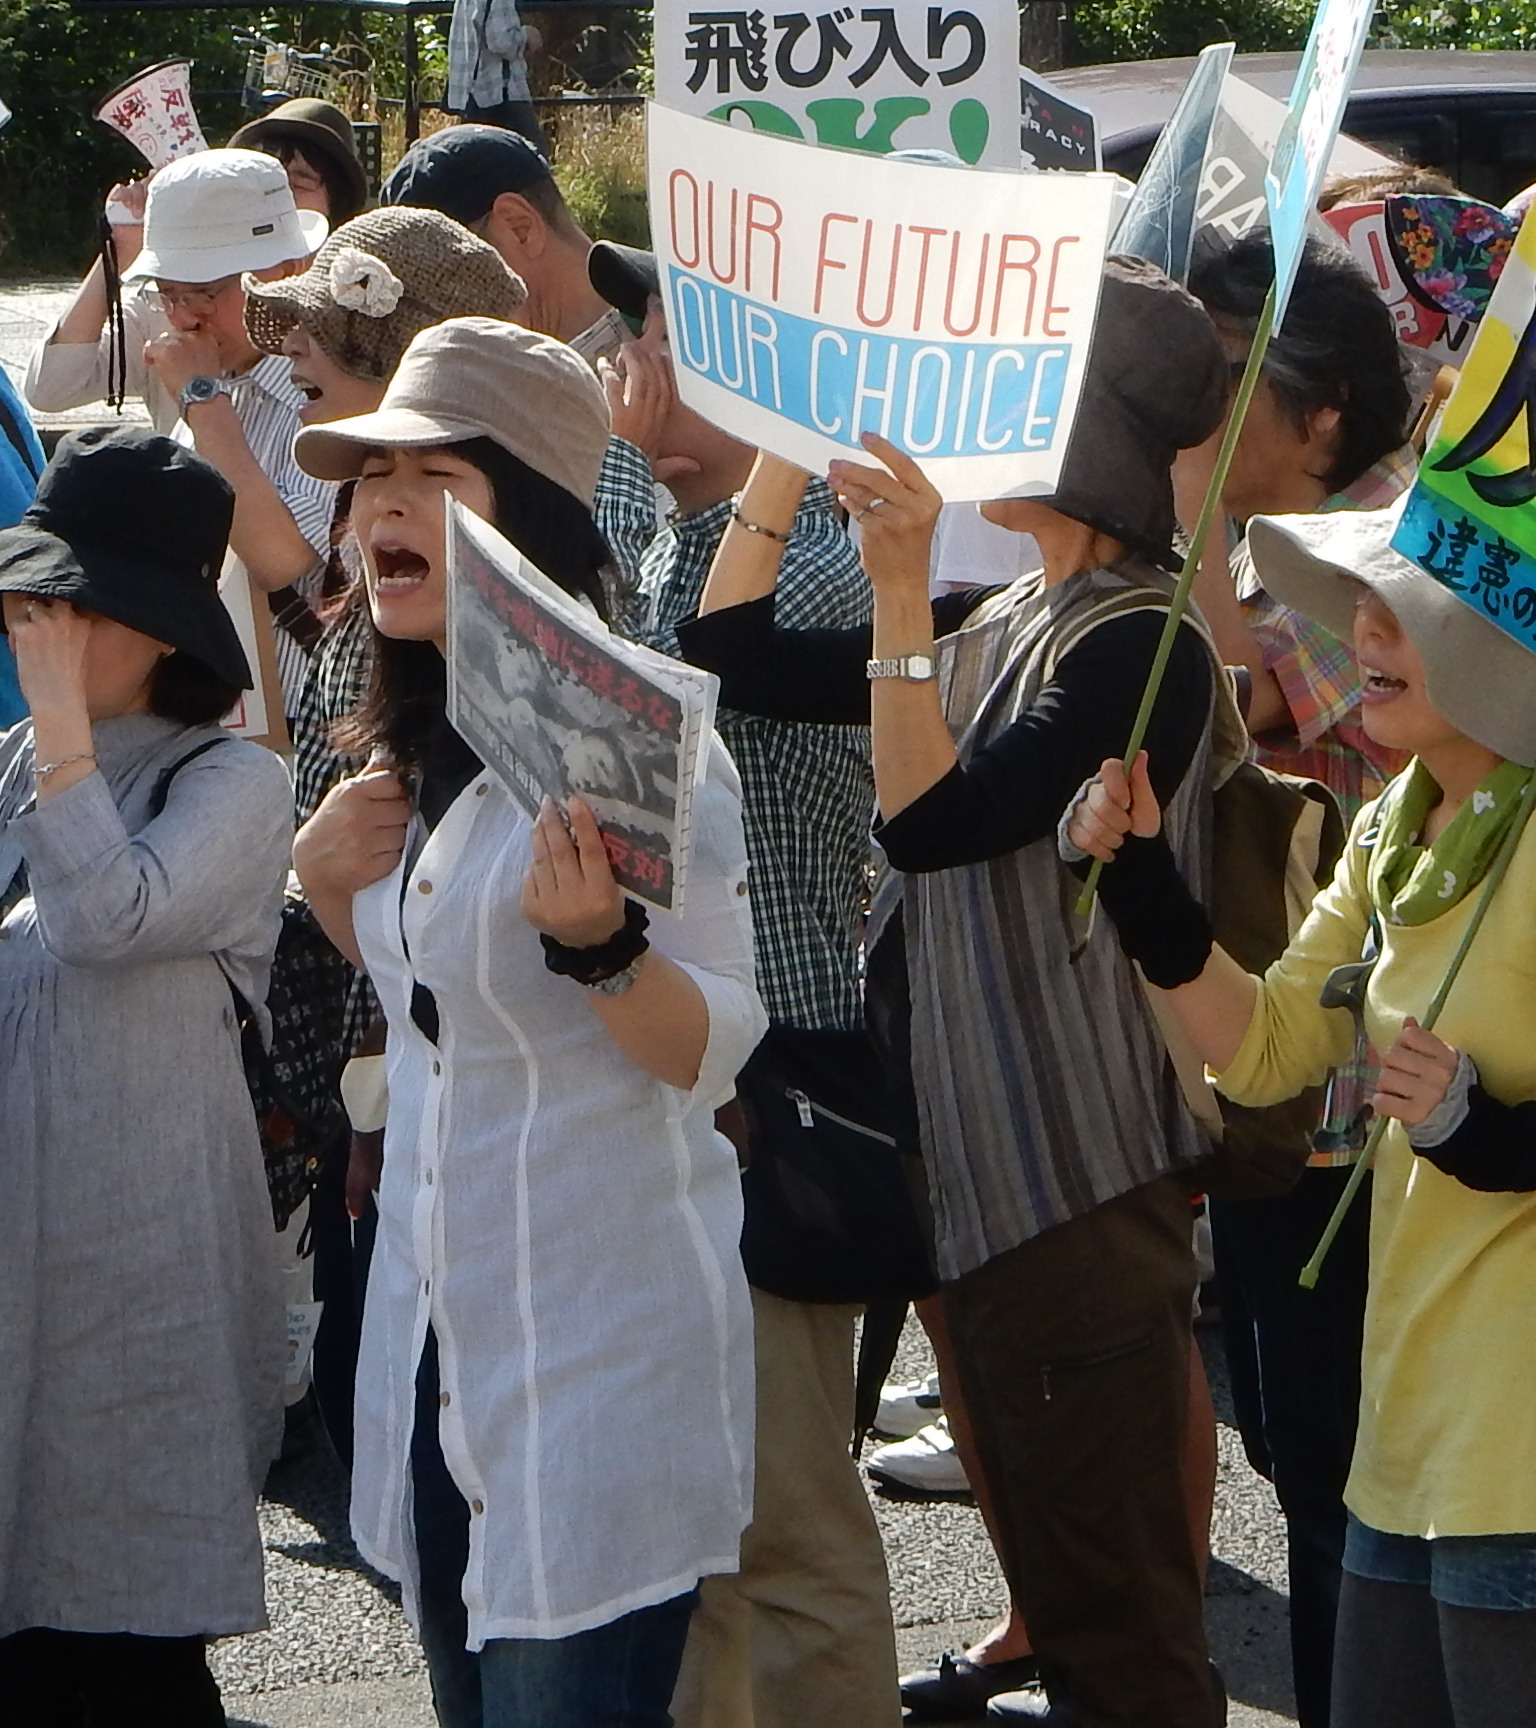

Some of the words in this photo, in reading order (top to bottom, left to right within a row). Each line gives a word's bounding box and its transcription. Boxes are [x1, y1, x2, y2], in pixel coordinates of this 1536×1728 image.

[684, 5, 988, 94] 飛び入り
[667, 167, 784, 302] OUR
[813, 212, 1081, 338] FUTURE
[674, 274, 784, 411] OUR
[809, 328, 1065, 454] CHOICE
